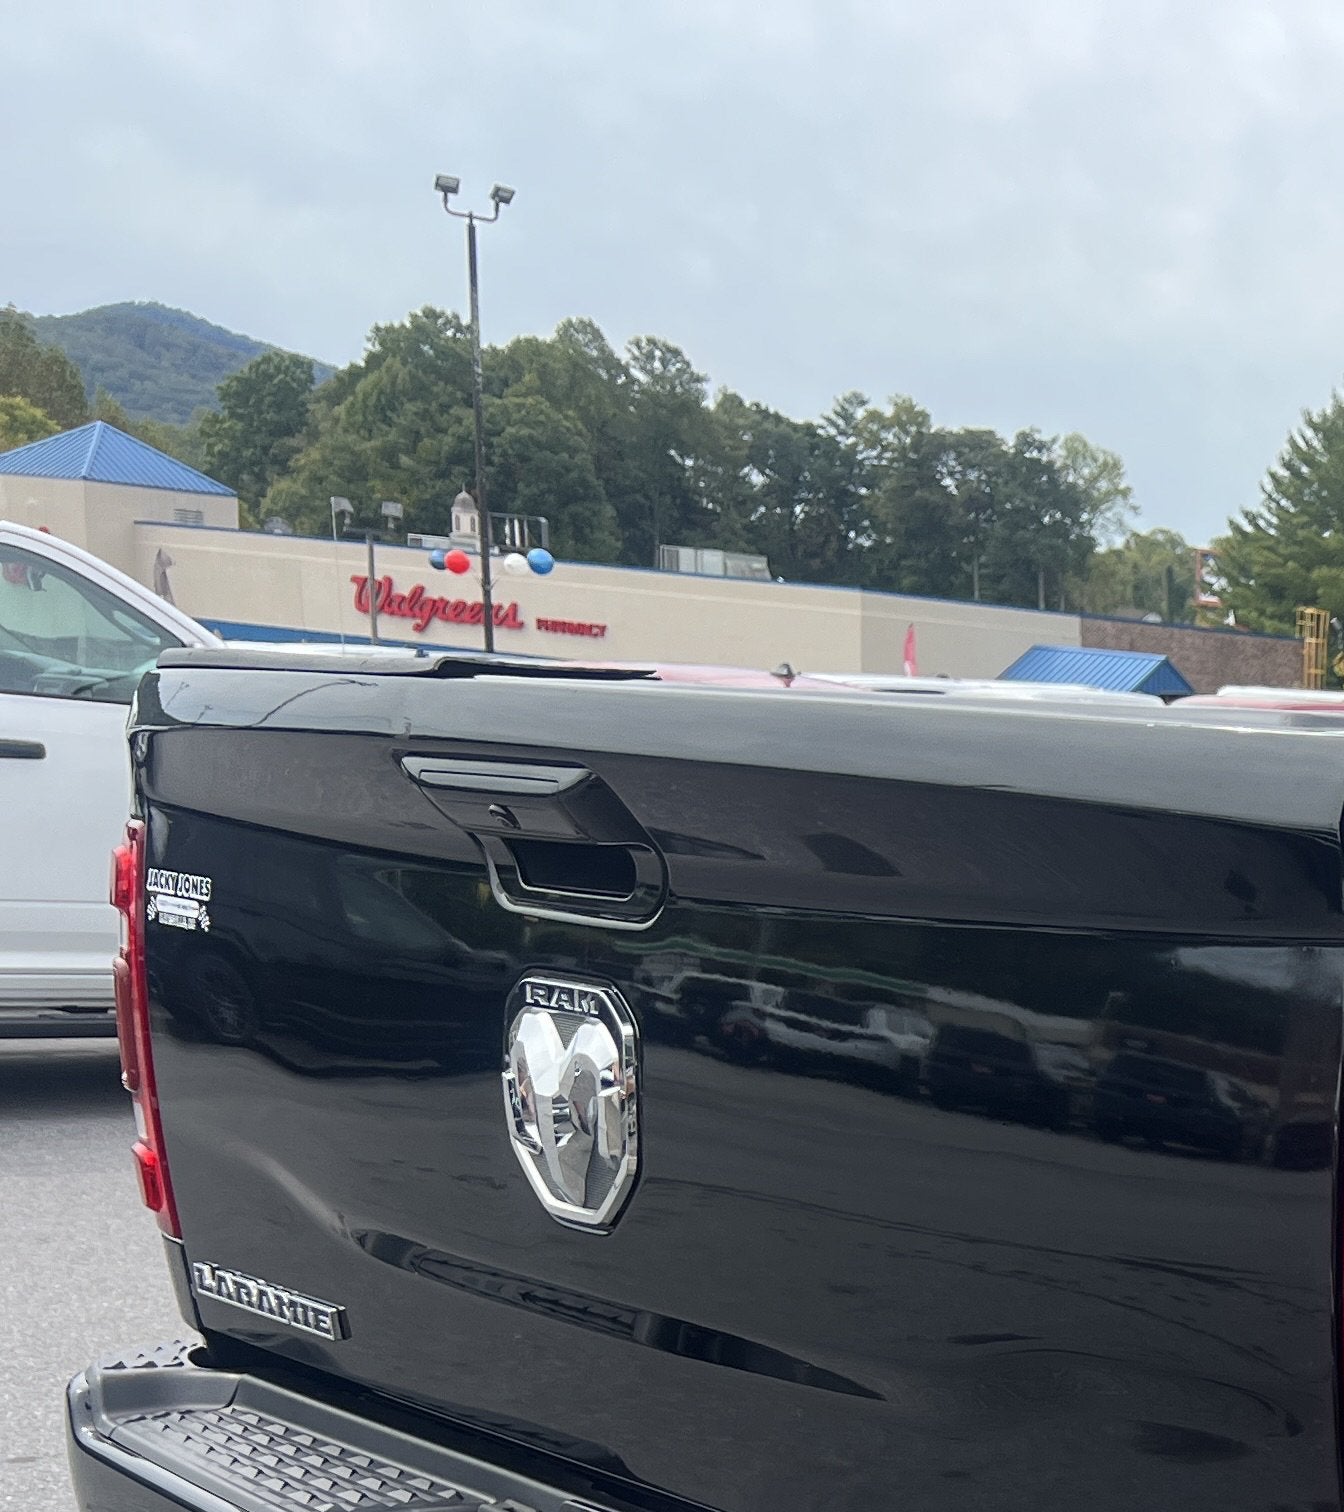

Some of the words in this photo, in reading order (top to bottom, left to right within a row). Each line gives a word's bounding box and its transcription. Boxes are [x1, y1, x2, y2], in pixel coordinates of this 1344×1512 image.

[147, 868, 178, 894] JACKY
[177, 873, 211, 901] JONES
[525, 983, 599, 1015] RAM
